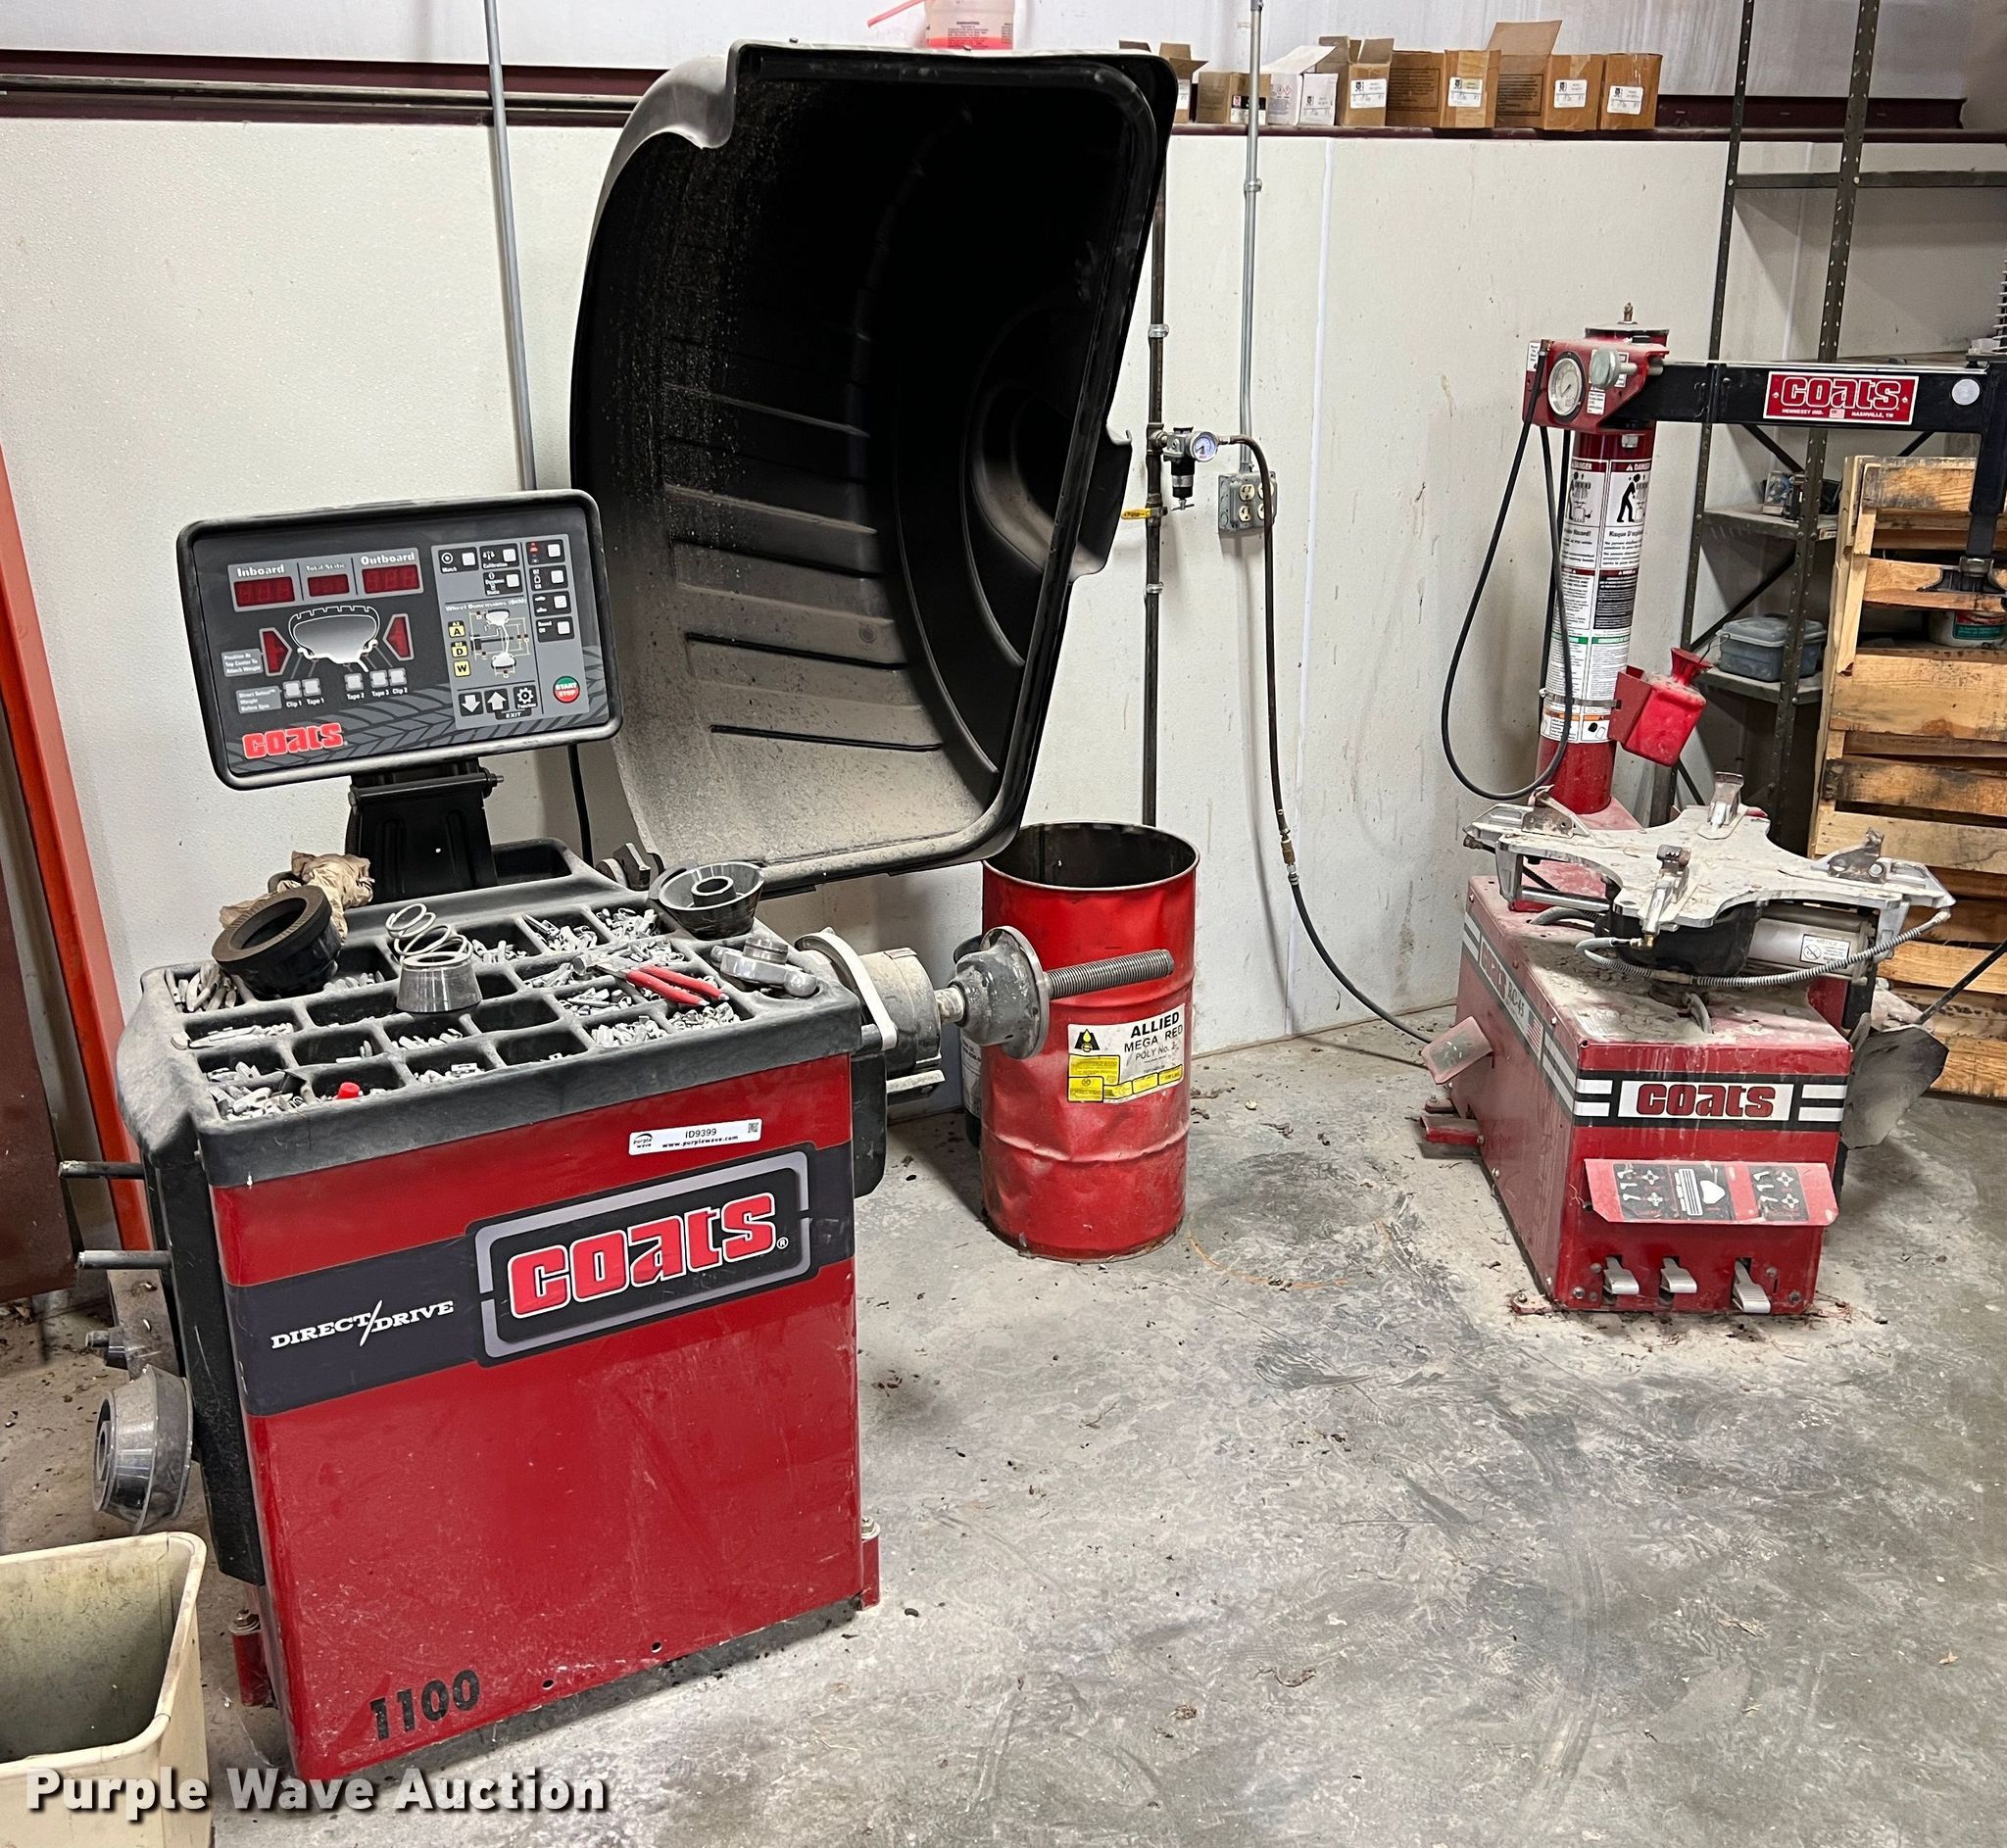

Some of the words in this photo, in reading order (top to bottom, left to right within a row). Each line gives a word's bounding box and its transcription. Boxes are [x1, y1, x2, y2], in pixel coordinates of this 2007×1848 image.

[361, 552, 416, 565] Outboard
[237, 563, 285, 578] Inboard
[454, 627, 462, 636] A
[555, 682, 577, 691] START
[1131, 1011, 1180, 1039] ALLIED
[1124, 1035, 1158, 1052] MEGA
[1164, 1024, 1183, 1041] RED
[1135, 1048, 1156, 1061] POLY
[1157, 1045, 1169, 1055] No.
[685, 1128, 717, 1139] ID9399
[662, 1135, 739, 1148] www.purplewave.com
[369, 1668, 481, 1742] 1100
